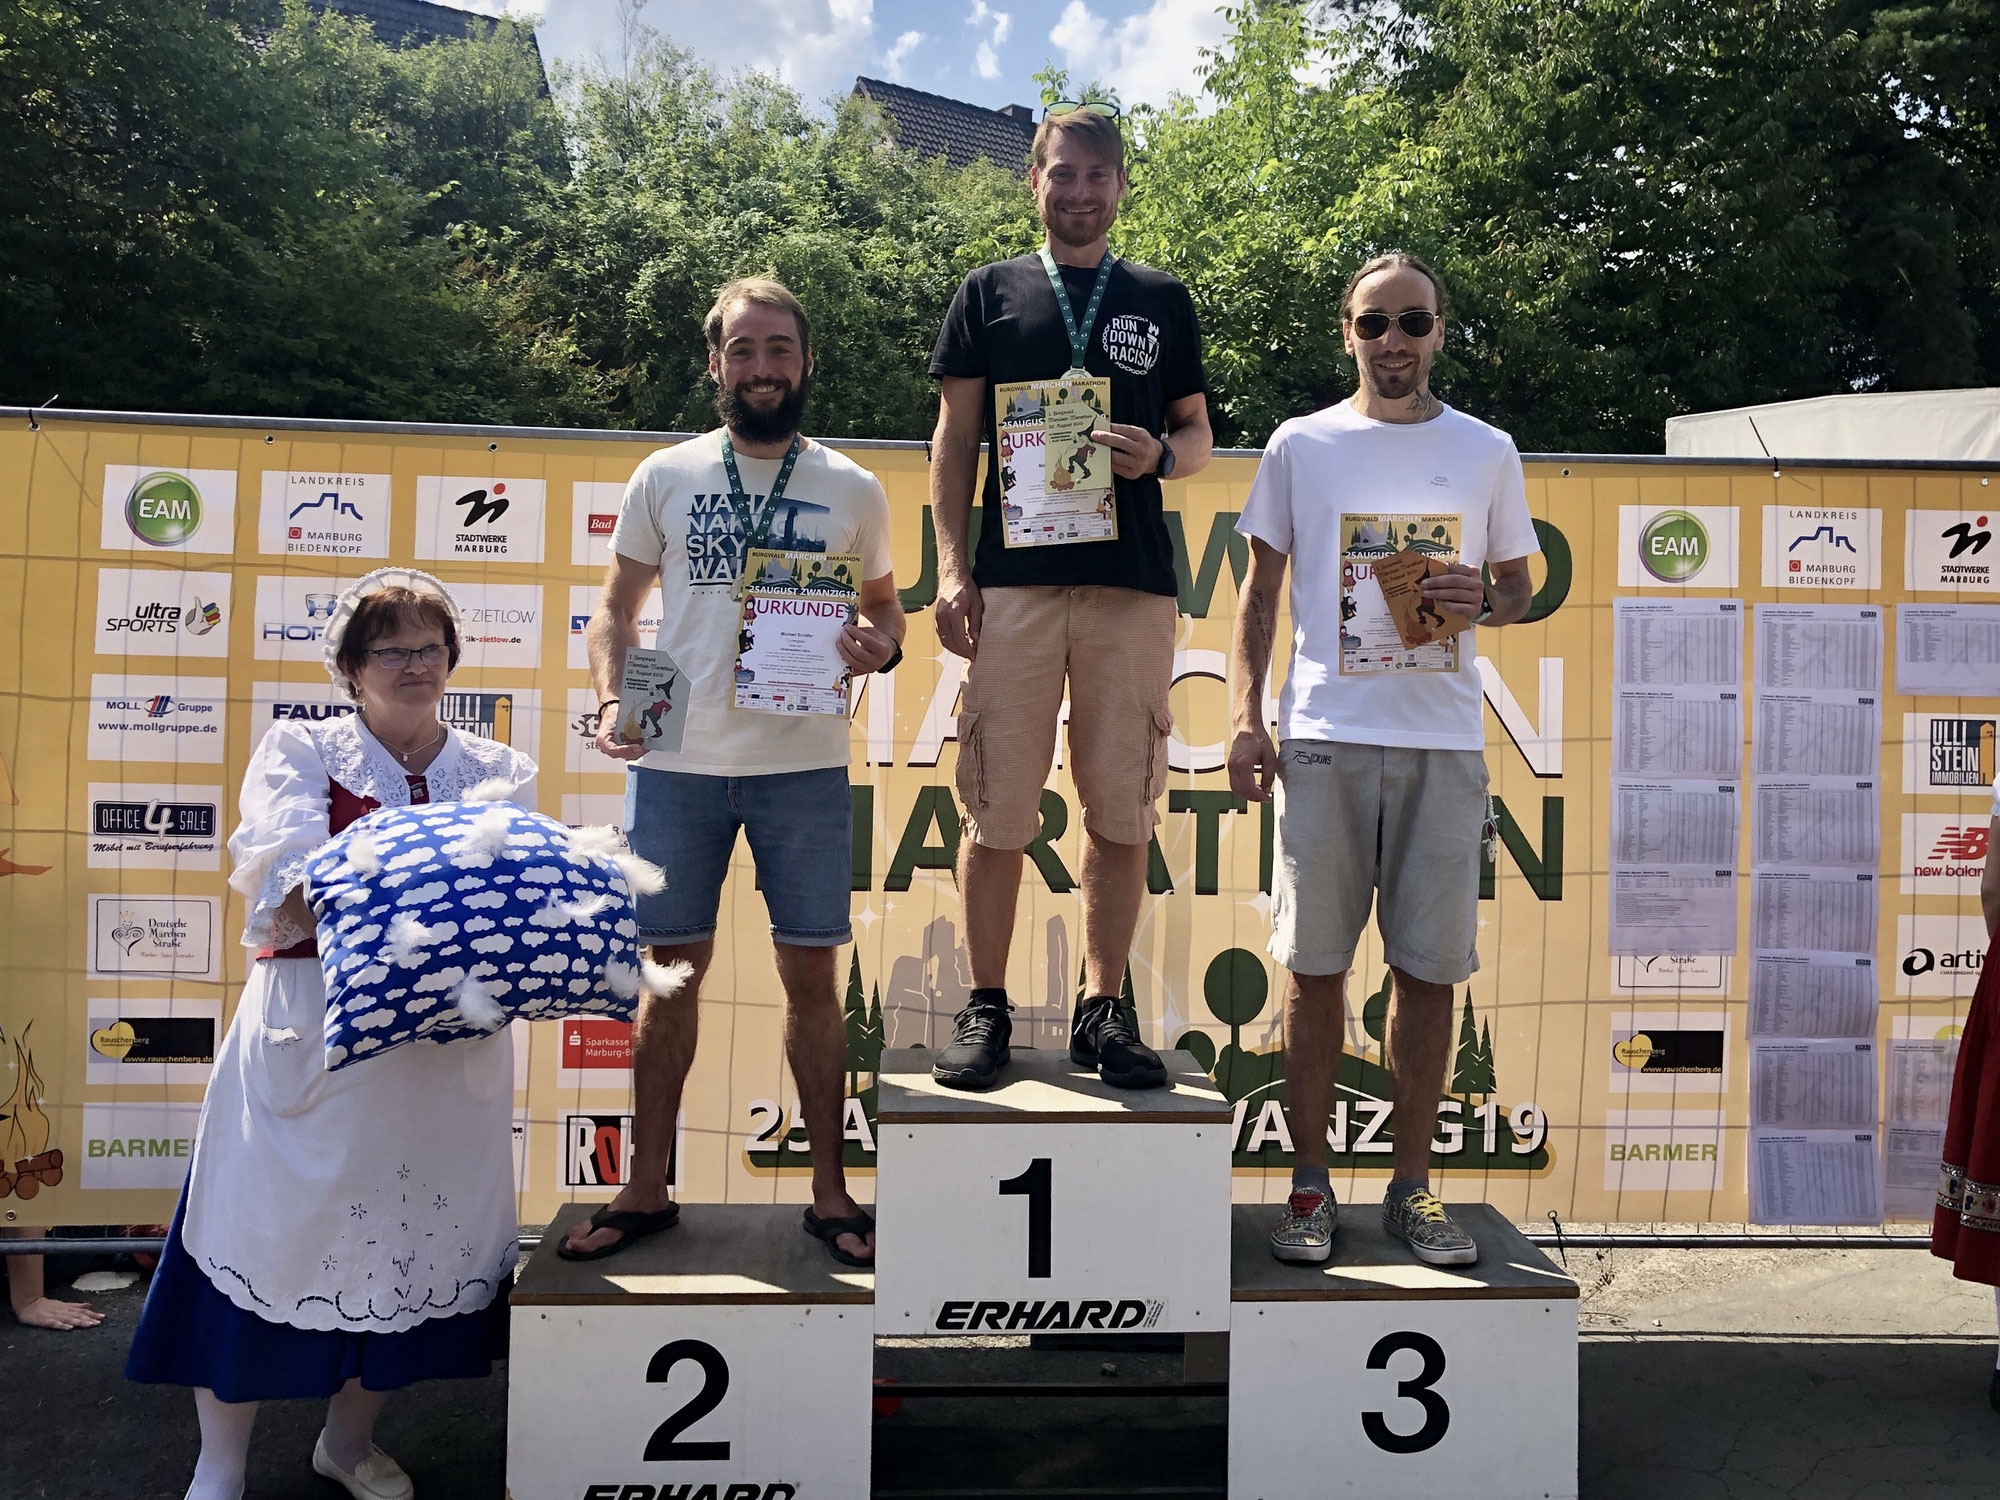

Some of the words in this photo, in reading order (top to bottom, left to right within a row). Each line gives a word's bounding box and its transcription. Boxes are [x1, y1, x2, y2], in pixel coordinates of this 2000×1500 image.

[1112, 318, 1137, 332] RUN
[1110, 330, 1146, 350] DOWN
[1002, 418, 1045, 430] 25AUGUS
[291, 476, 365, 486] LANDKREIS
[139, 498, 191, 520] EAM
[1789, 510, 1857, 520] LANDKREIS
[591, 518, 612, 529] Bad
[307, 532, 363, 542] MARBURG
[456, 533, 507, 544] STADTWERKE
[288, 543, 362, 554] BIEDENKOPF
[454, 544, 508, 554] MARBURG
[687, 534, 747, 558] SKY
[1651, 536, 1699, 556] EAM
[1806, 565, 1856, 574] MARBURG
[1941, 565, 1990, 574] STADTWERKE
[1789, 576, 1856, 585] BIEDENKOPF
[1940, 575, 1991, 584] MARBURG
[136, 603, 181, 619] ultra
[757, 599, 845, 619] URKUNDE
[472, 609, 536, 623] ZIETLOW
[106, 619, 178, 633] SPORTS
[106, 701, 141, 710] MOLL
[178, 703, 213, 713] Gruppe
[443, 695, 481, 721] ULLI
[98, 722, 218, 734] www.mollgruppe.de
[1932, 721, 1967, 746] ULLI
[1931, 746, 1979, 771] STEIN
[1931, 771, 1979, 785] IMMOBILIEN
[102, 808, 141, 829] OFFICE
[144, 798, 174, 840] 4
[180, 810, 207, 830] SALE
[93, 843, 123, 852] Möbel
[126, 843, 142, 851] mit
[145, 841, 214, 853] Berufserfahrung
[1914, 866, 1942, 877] new
[1946, 864, 1985, 877] balan
[148, 918, 187, 928] Deutsche
[152, 938, 182, 947] Straße
[100, 1036, 150, 1045] Rauschenberg
[585, 1037, 630, 1047] Sparkasse
[1621, 1047, 1666, 1056] Rauschenberg
[125, 1055, 213, 1064] www.rauschenberg.de
[1642, 1065, 1722, 1074] www.rauschenberg.de
[88, 1138, 195, 1158] BARME
[1610, 1143, 1718, 1162] BARMER
[999, 1158, 1051, 1278] 1
[935, 1299, 1147, 1330] ERHARD
[1361, 1331, 1450, 1454] 3
[643, 1339, 730, 1462] 2
